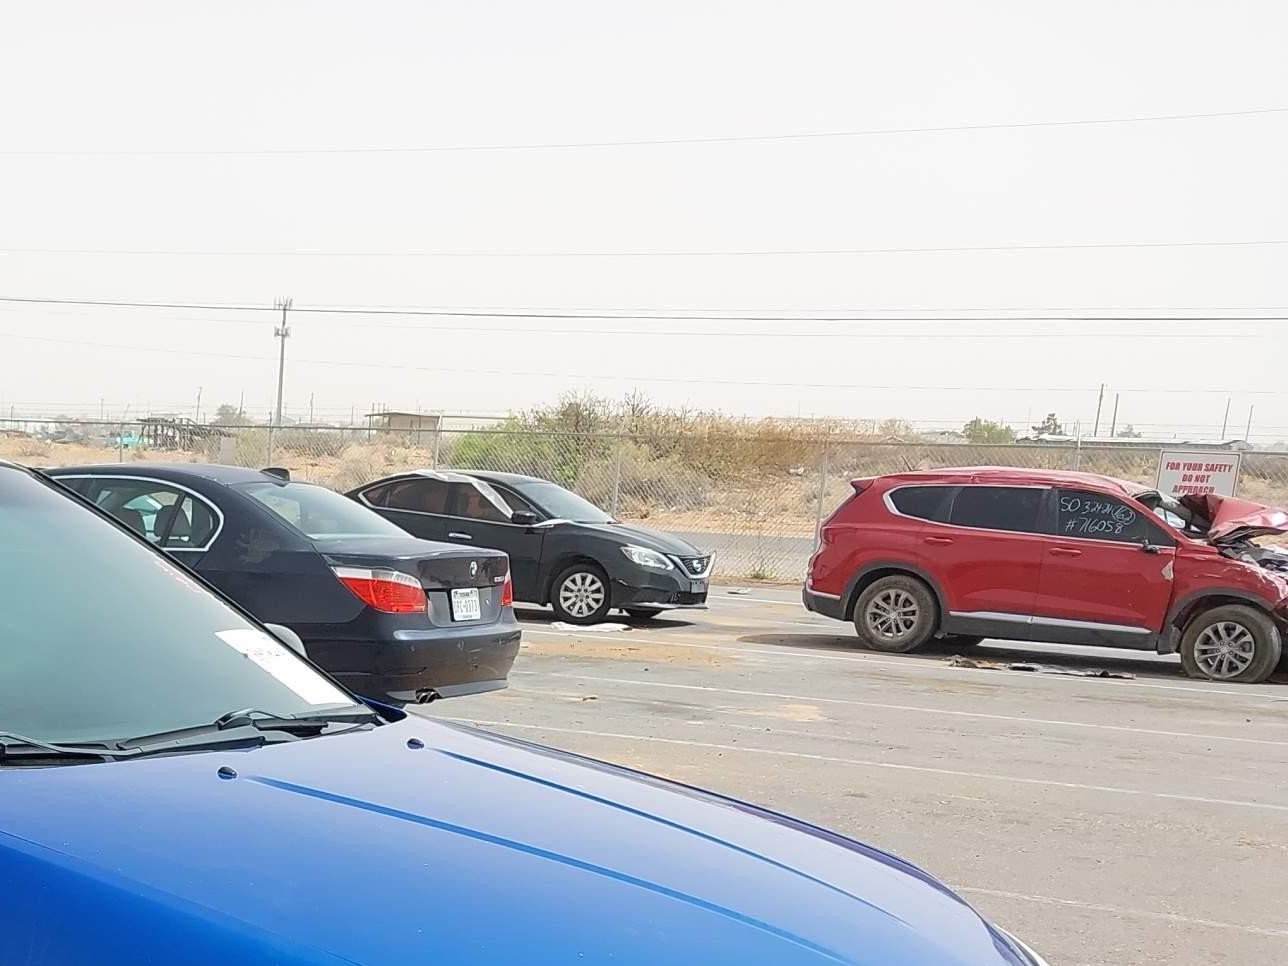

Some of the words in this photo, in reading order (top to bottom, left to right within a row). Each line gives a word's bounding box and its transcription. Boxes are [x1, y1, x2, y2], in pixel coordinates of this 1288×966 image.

[1166, 461, 1180, 470] FOR
[1182, 462, 1203, 471] YOUR
[1204, 463, 1233, 473] SAFETY
[1182, 473, 1193, 482] DO
[1194, 474, 1211, 483] NOT
[1172, 485, 1215, 494] APPROACH
